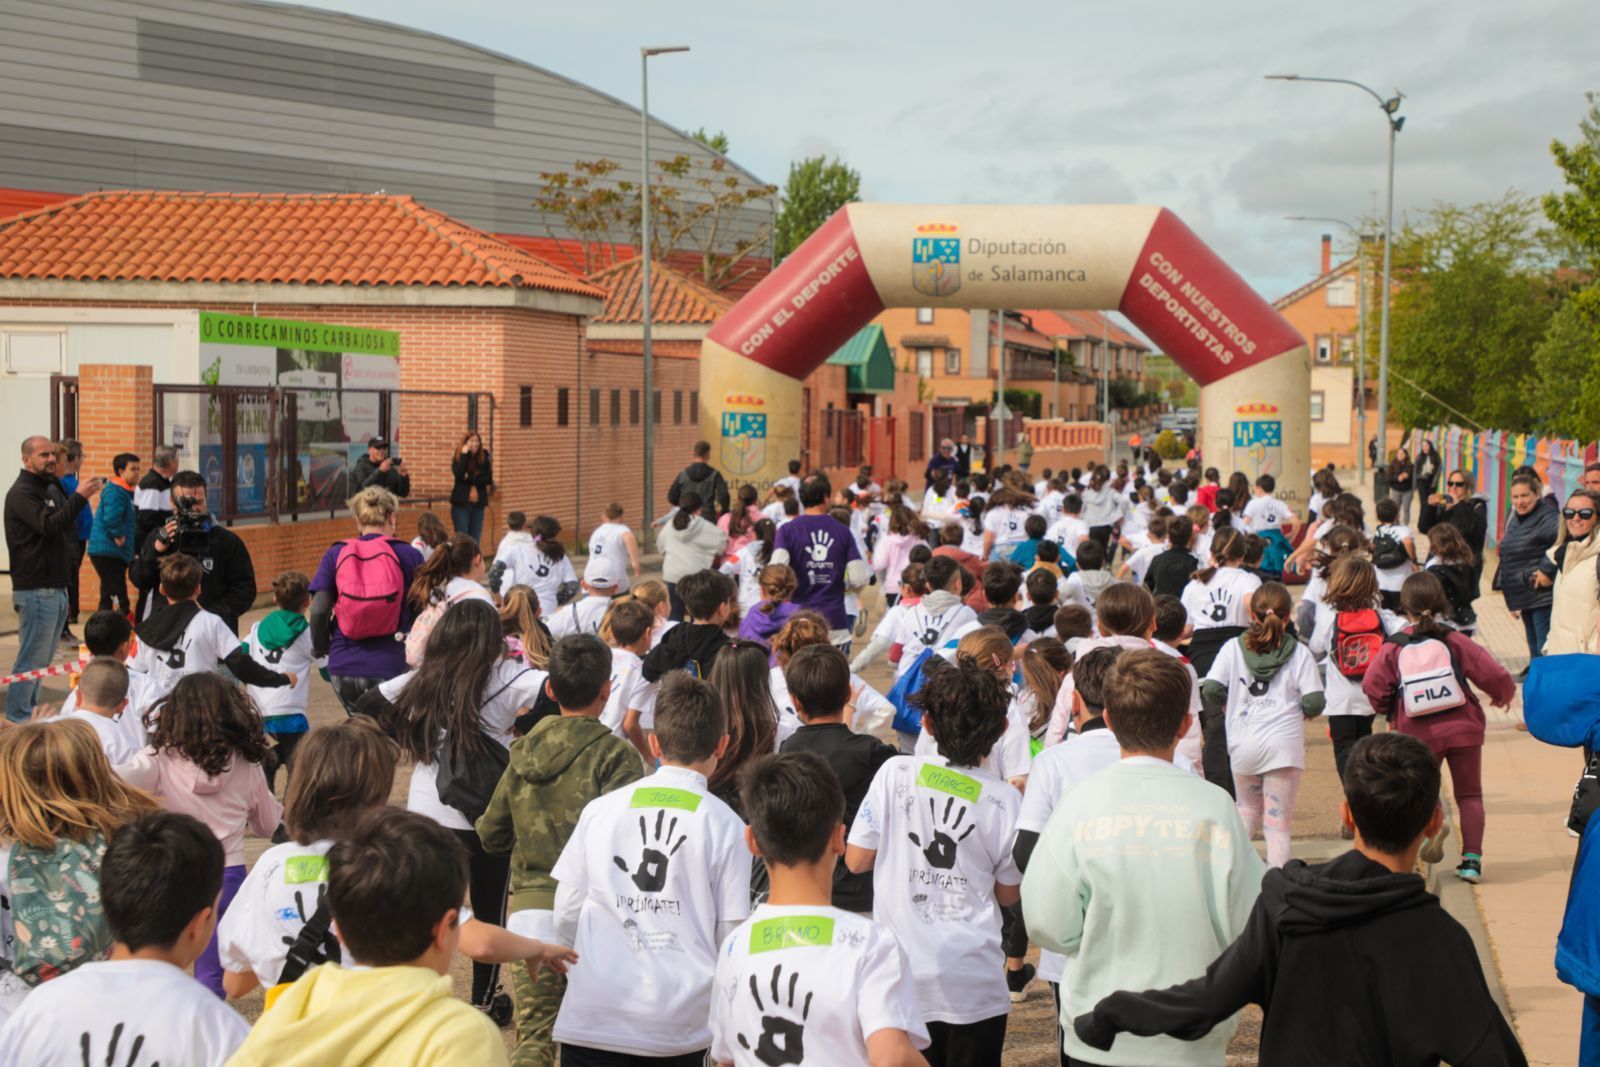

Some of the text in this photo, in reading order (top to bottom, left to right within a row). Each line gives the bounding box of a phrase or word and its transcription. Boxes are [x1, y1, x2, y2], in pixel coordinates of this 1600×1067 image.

[968, 237, 1066, 257] Diputación
[968, 265, 1086, 282] de Salamanca
[740, 245, 859, 355] CON EL DEPORTE
[1149, 251, 1257, 355] CON NUESTROS
[1139, 272, 1234, 365] DEPORTISTAS
[218, 319, 386, 350] CORRECAMINOS CARBAJOSA
[1412, 685, 1452, 703] FILA
[927, 771, 975, 796] MARCO
